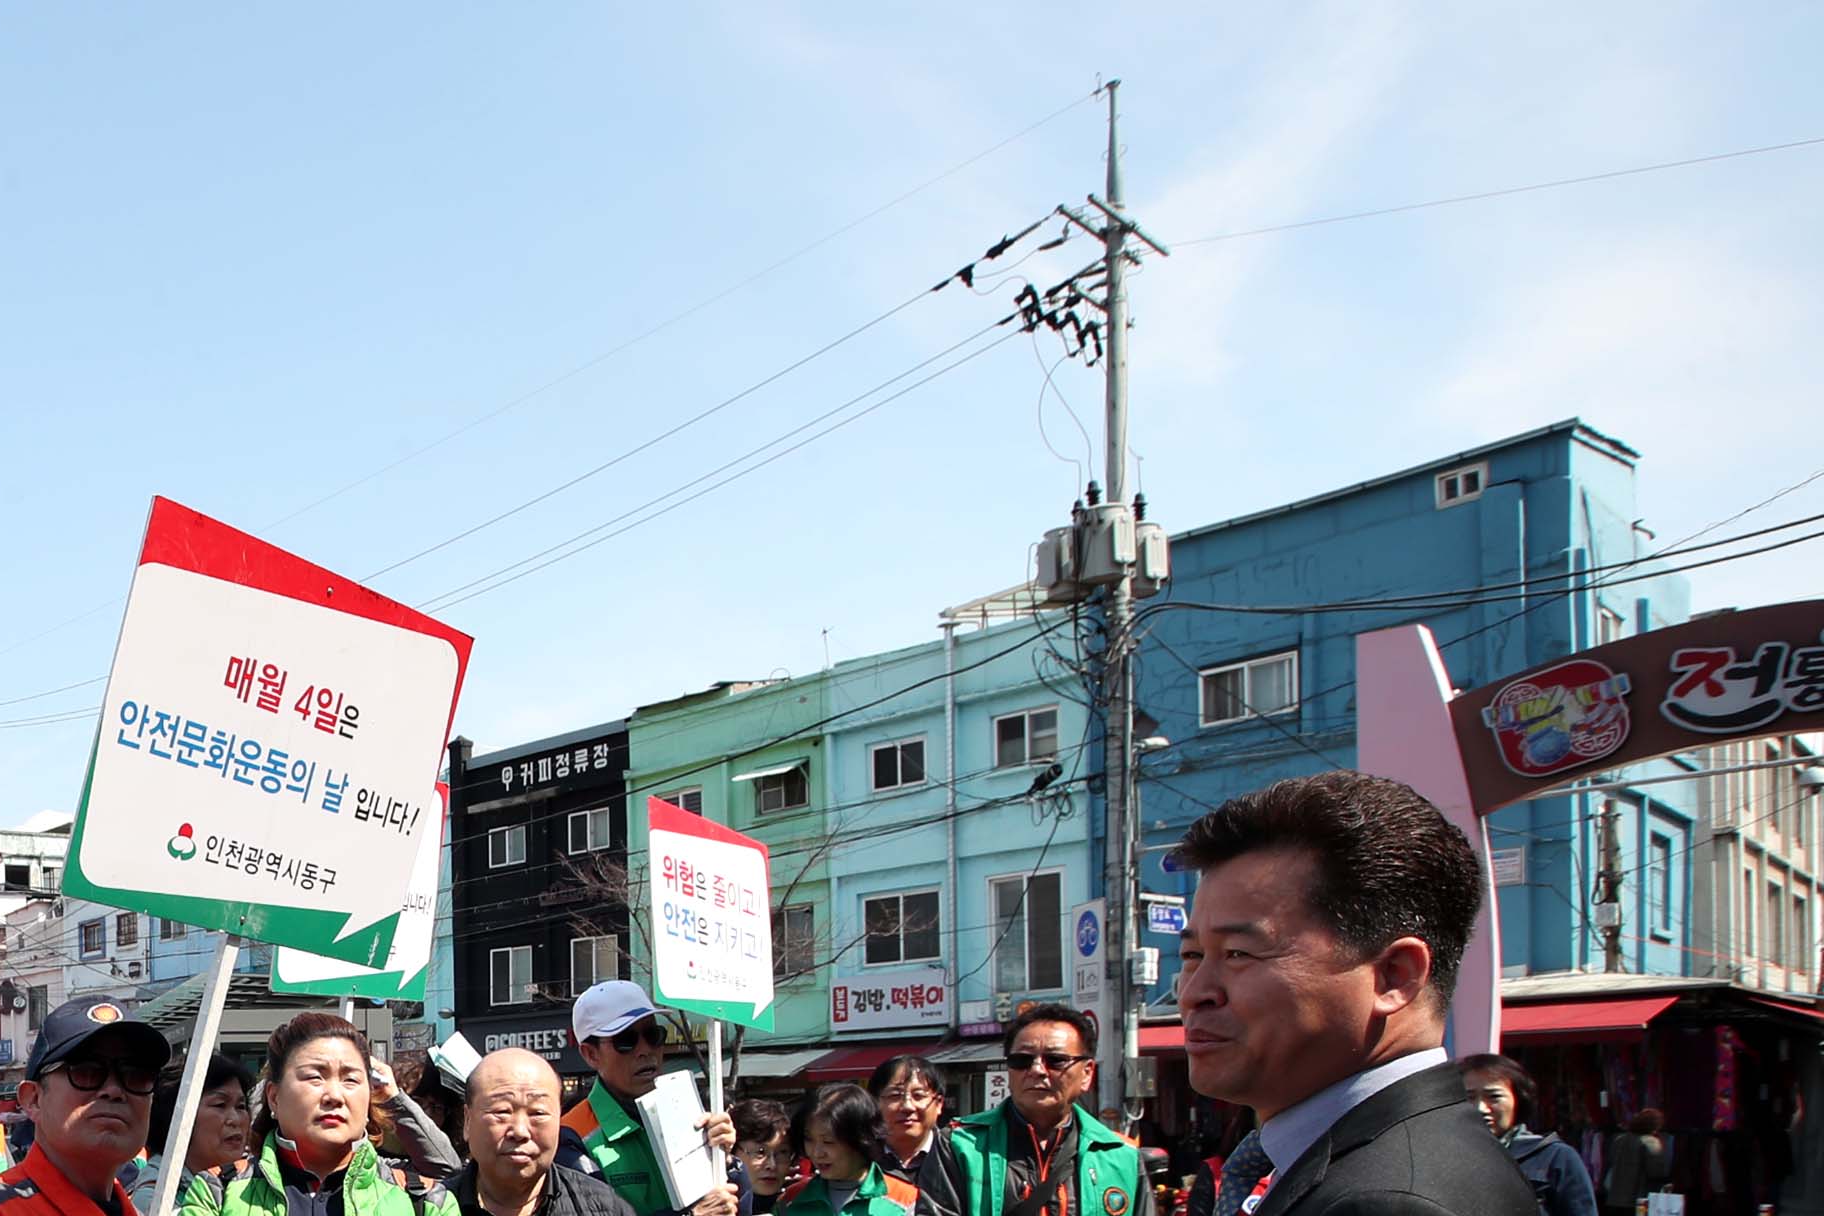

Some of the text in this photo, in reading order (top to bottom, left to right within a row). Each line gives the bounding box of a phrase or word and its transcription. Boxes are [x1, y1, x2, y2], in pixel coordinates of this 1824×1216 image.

[223, 655, 361, 740] 매월 4일은
[118, 700, 421, 837] 안전문화운동의 날 입니다!
[520, 743, 609, 787] 커피정류장
[204, 834, 337, 896] 인천광역시동구
[662, 855, 762, 918] 위험은 줄이고!
[663, 902, 763, 962] 안전은 지키고!
